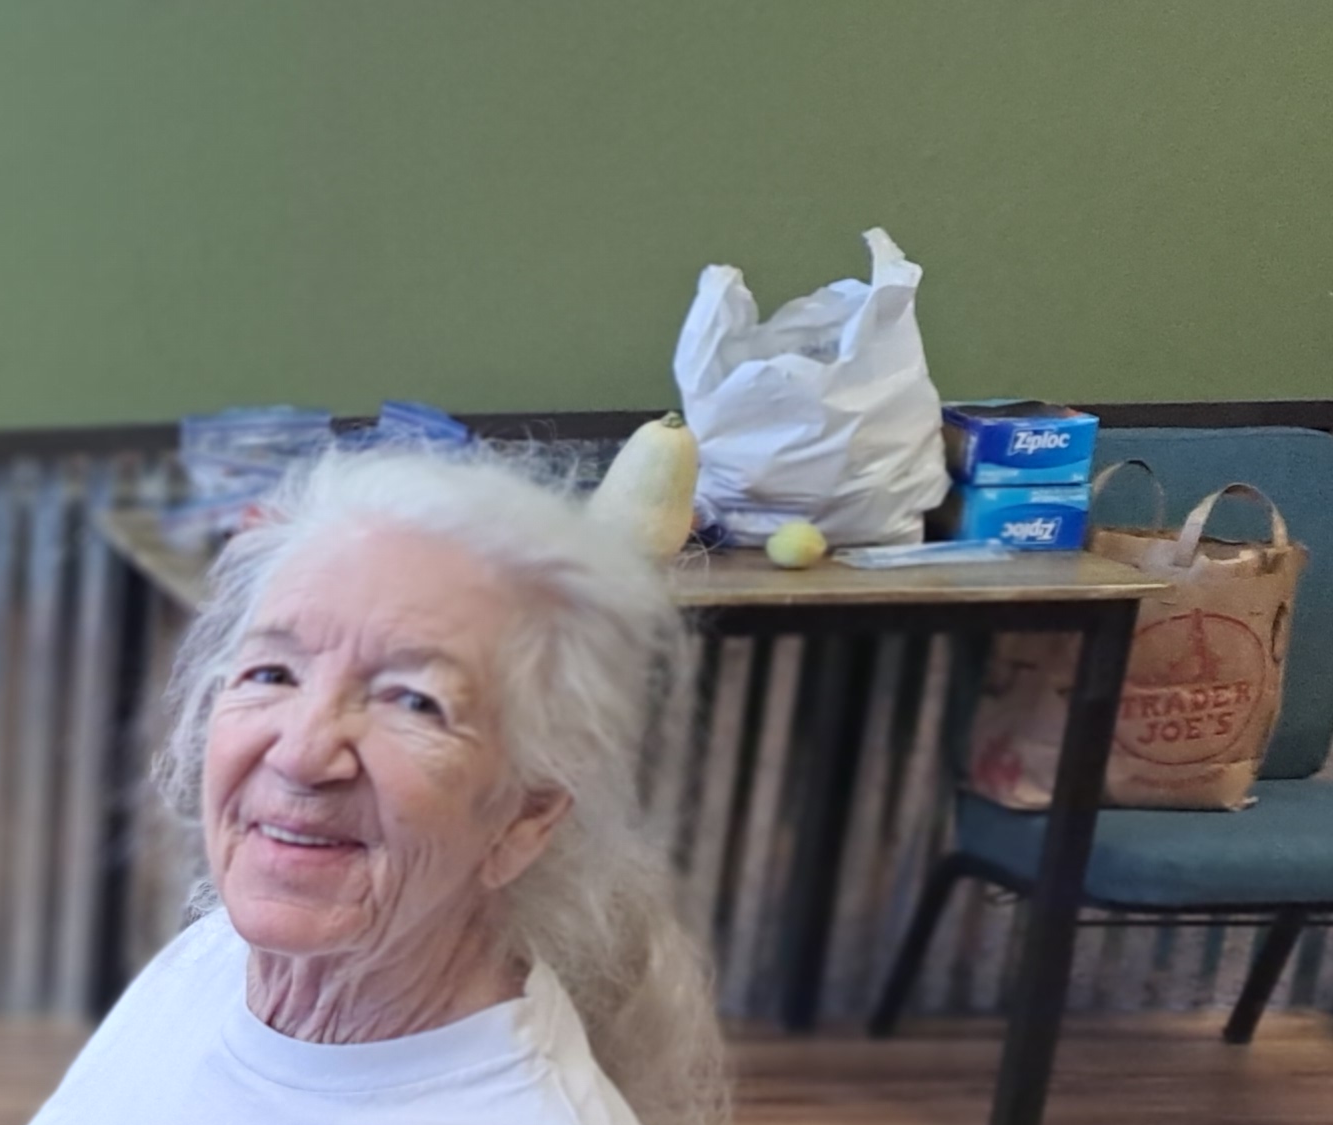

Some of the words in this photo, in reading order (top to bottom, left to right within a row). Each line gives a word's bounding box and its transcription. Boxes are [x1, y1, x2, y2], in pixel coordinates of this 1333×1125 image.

[1013, 430, 1071, 455] Ziploc
[1000, 518, 1056, 541] Ziploc
[1121, 681, 1251, 720] TRADER
[1136, 711, 1234, 744] JOE'S
